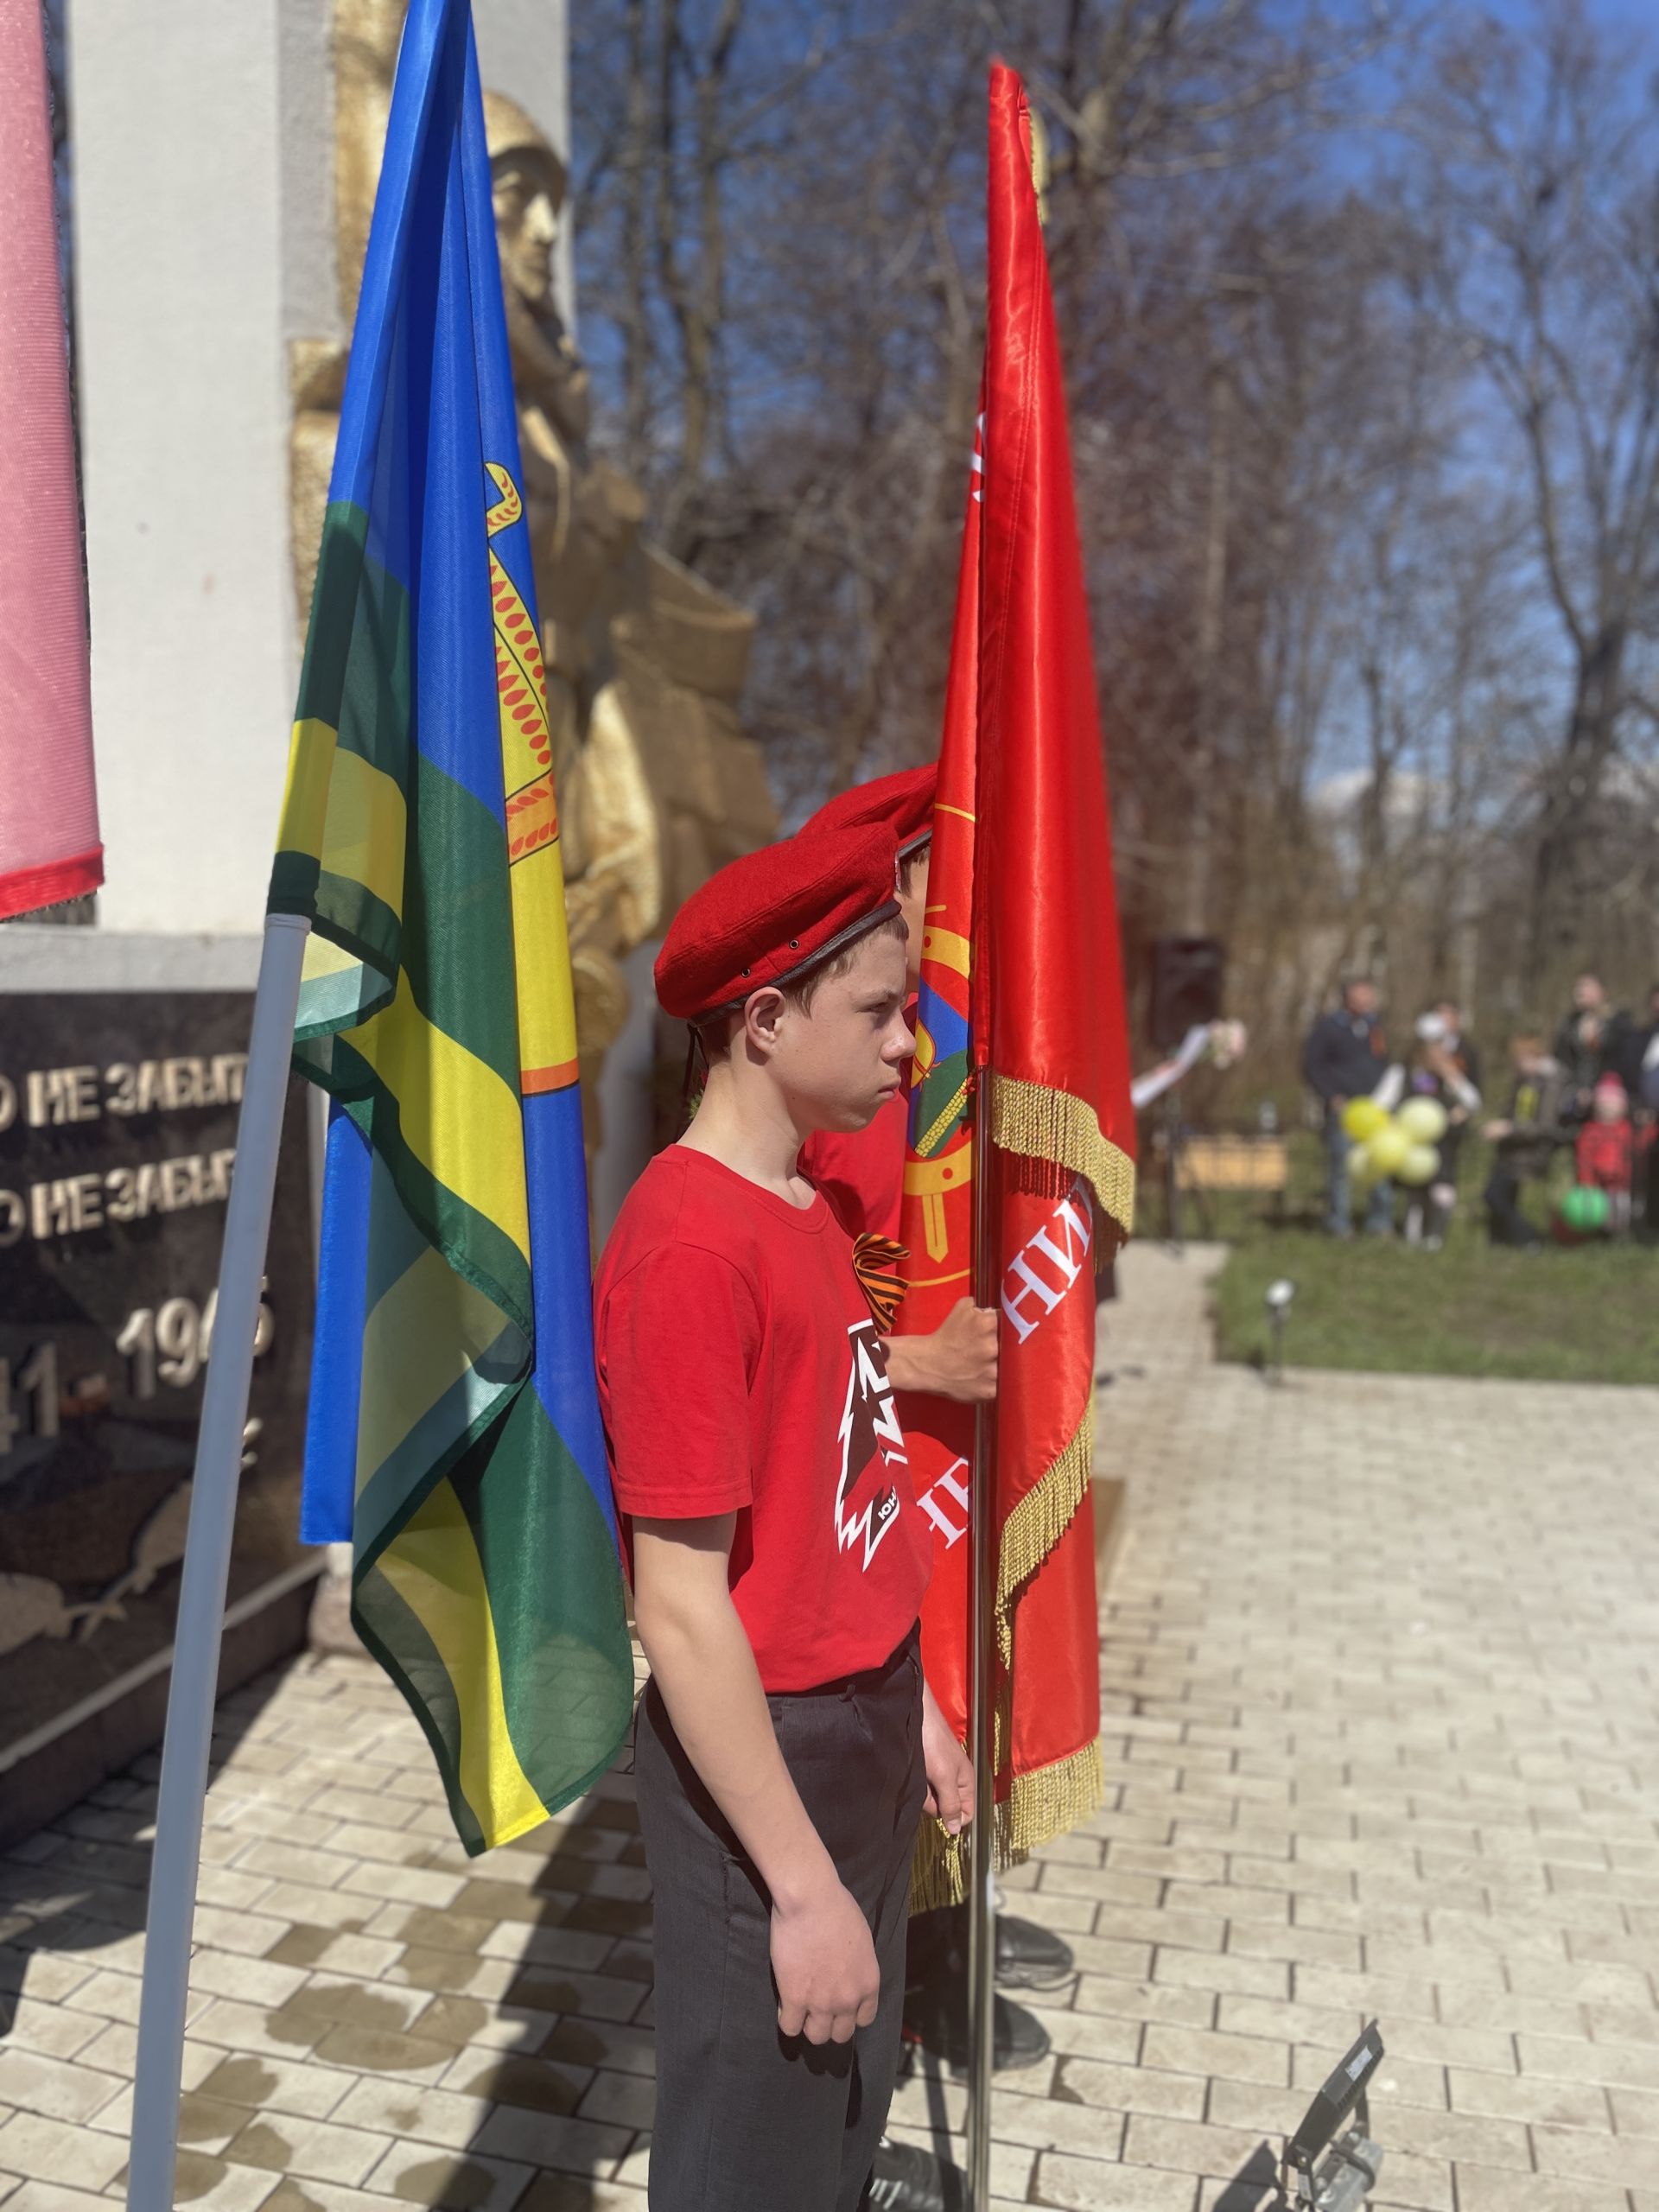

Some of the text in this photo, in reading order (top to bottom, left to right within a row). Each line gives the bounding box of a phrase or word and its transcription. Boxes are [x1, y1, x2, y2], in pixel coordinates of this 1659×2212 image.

[27, 1065, 100, 1127] НЕ
[31, 1173, 104, 1239] НЕ
[105, 1148, 237, 1222] ЗАБЫ
